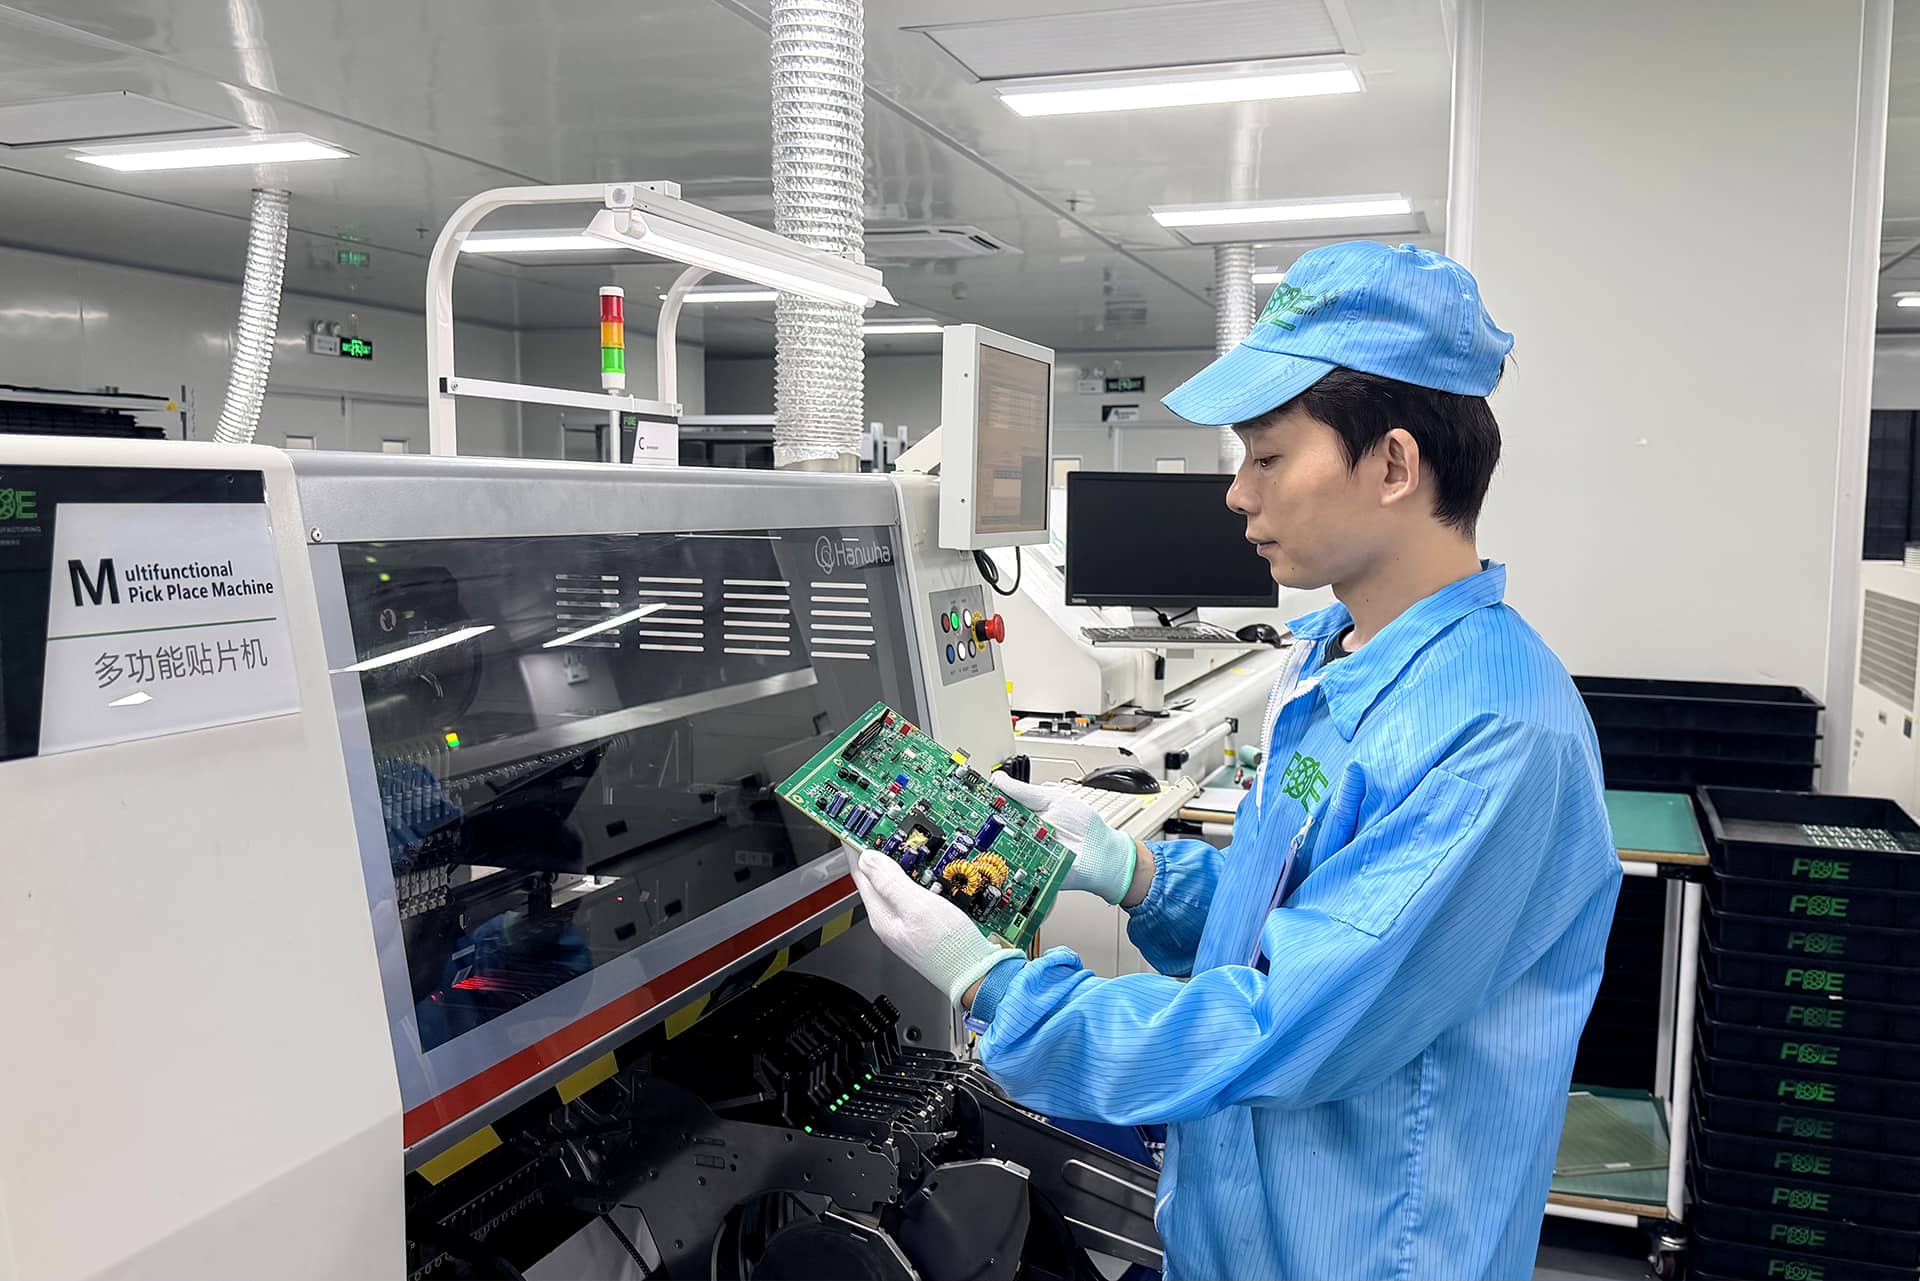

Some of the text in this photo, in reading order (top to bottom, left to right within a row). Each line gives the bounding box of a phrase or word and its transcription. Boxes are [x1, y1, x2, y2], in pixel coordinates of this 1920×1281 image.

[834, 540, 891, 567] Hanwha
[125, 560, 234, 582] ultifunctional
[128, 579, 274, 603] Pick Place Machine
[95, 637, 268, 689] 多功能贴片机
